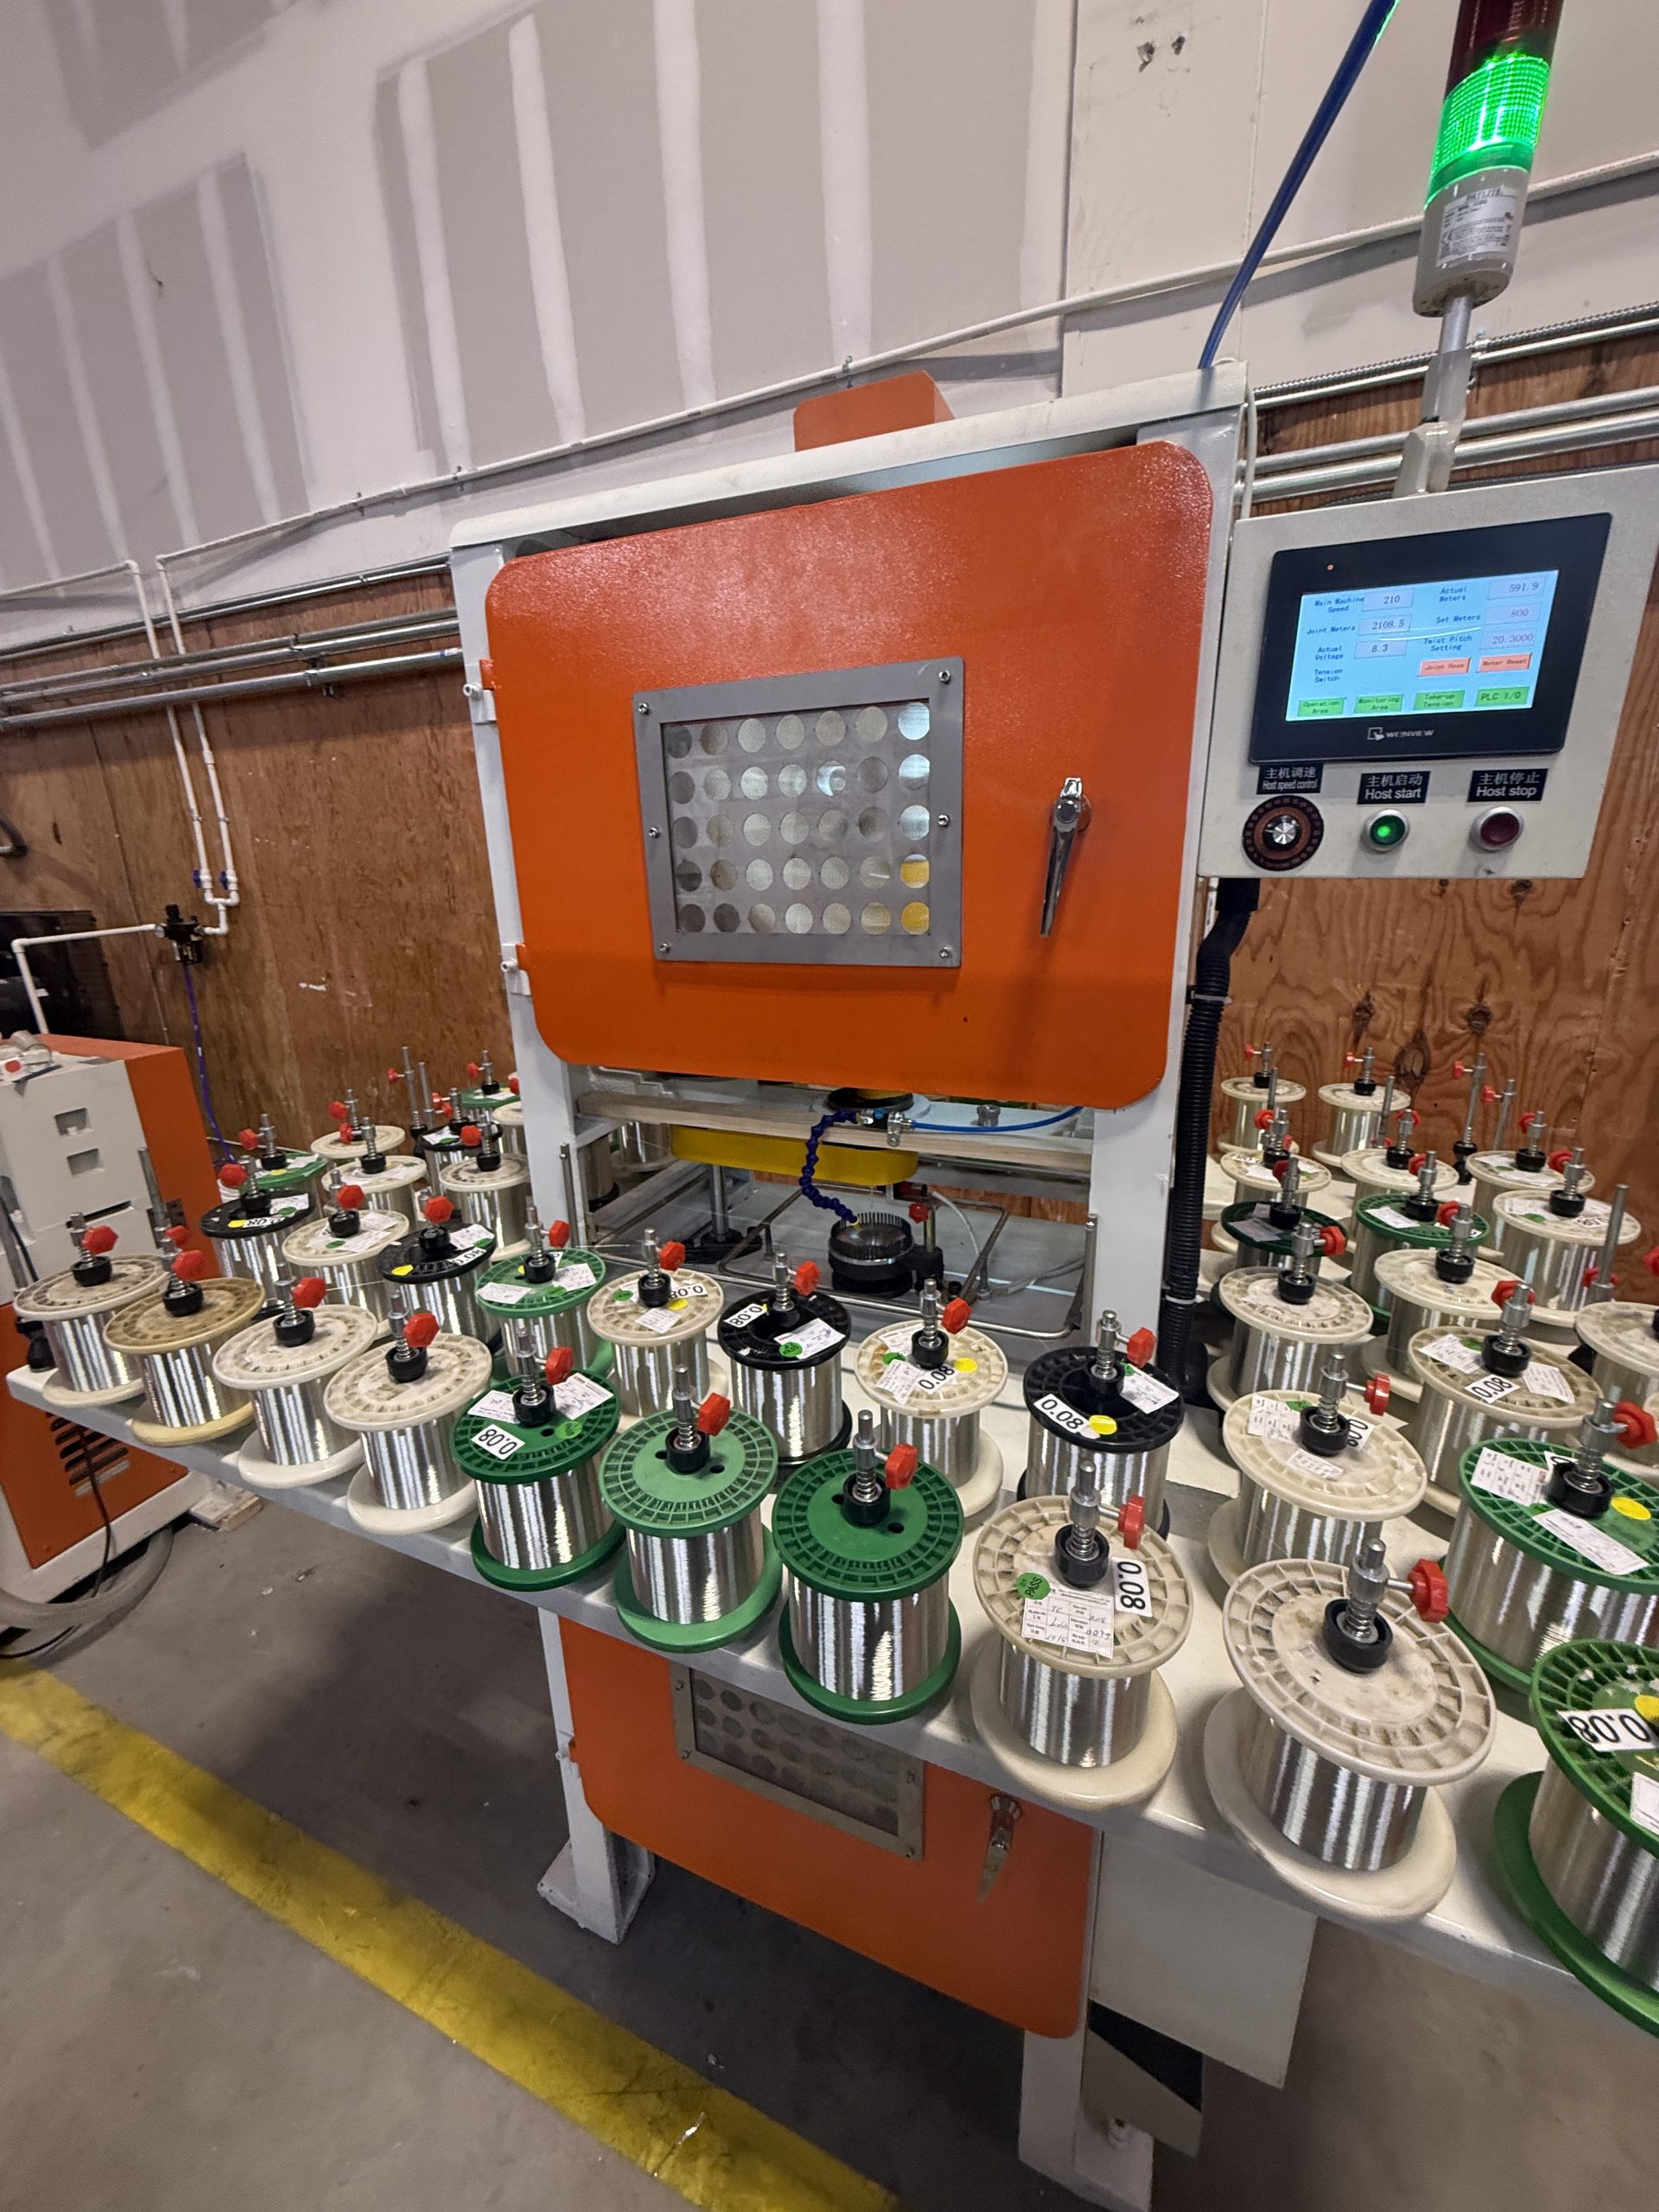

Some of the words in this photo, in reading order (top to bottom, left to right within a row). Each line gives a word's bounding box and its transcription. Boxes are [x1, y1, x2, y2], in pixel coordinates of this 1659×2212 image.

[1440, 586, 1467, 594] Actual
[1509, 582, 1540, 593] 591.9
[1314, 597, 1332, 607] Main
[1335, 596, 1364, 605] Machine
[1383, 594, 1400, 605] 210
[1328, 605, 1349, 613] Speed
[1510, 608, 1529, 618] 800
[1306, 626, 1326, 635] Joint
[1371, 620, 1405, 631] 2108.5
[1424, 637, 1446, 645] Twist
[1450, 635, 1472, 644] Pitch
[1492, 632, 1534, 645] 20.3000
[1371, 644, 1389, 653] 8.3
[1358, 696, 1400, 705] Monitoring
[1481, 693, 1499, 702] PLC
[1504, 691, 1522, 701] I/O
[1302, 700, 1341, 709] Operation
[1265, 766, 1318, 779] 主机调速
[1478, 772, 1540, 785] 主机停止
[1262, 780, 1277, 791] Host
[1278, 779, 1296, 791] speed
[1297, 779, 1319, 790] control
[1367, 773, 1423, 787] 主机启动
[1364, 788, 1392, 800] Host
[1394, 787, 1421, 798] start
[1476, 786, 1506, 797] Host
[1509, 785, 1537, 798] stop
[729, 1306, 763, 1326] 0.08
[918, 1365, 955, 1389] 0.08
[1471, 1376, 1513, 1398] 0.08
[1041, 1399, 1084, 1429] 0.08
[478, 1428, 518, 1455] 0.08
[1026, 1577, 1042, 1597] PASS
[1117, 1561, 1146, 1610] 0.08
[1567, 1713, 1651, 1743] 0.08
